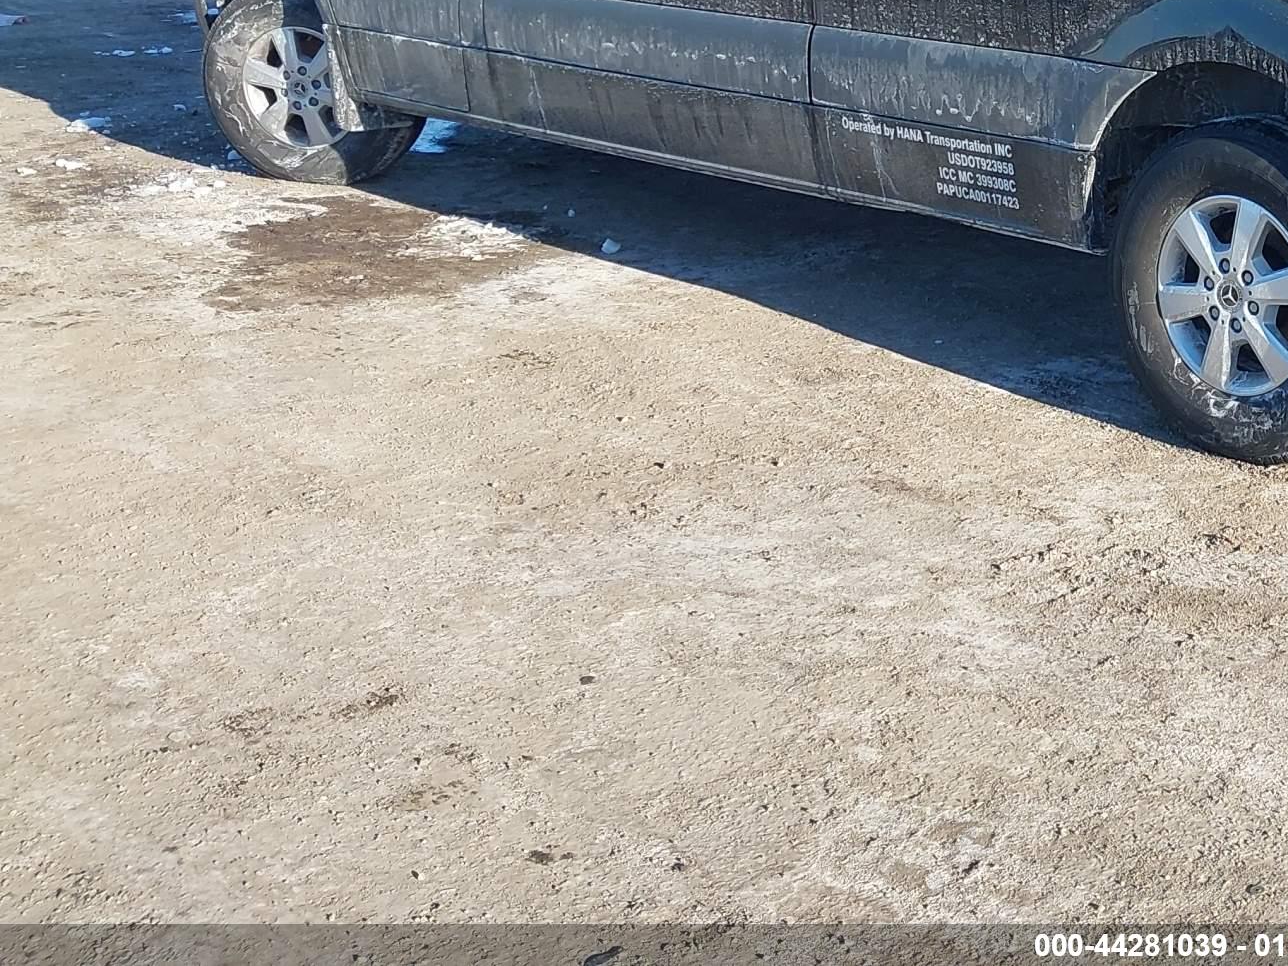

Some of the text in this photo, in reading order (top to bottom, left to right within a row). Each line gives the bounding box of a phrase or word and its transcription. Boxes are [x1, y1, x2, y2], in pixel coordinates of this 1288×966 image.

[841, 115, 1013, 158] Operated by HANA Transportation INC
[938, 166, 957, 181] ICC
[957, 170, 975, 184] MC
[947, 151, 1015, 176] USDOT923958
[936, 181, 1020, 210] PAPUCA00117423
